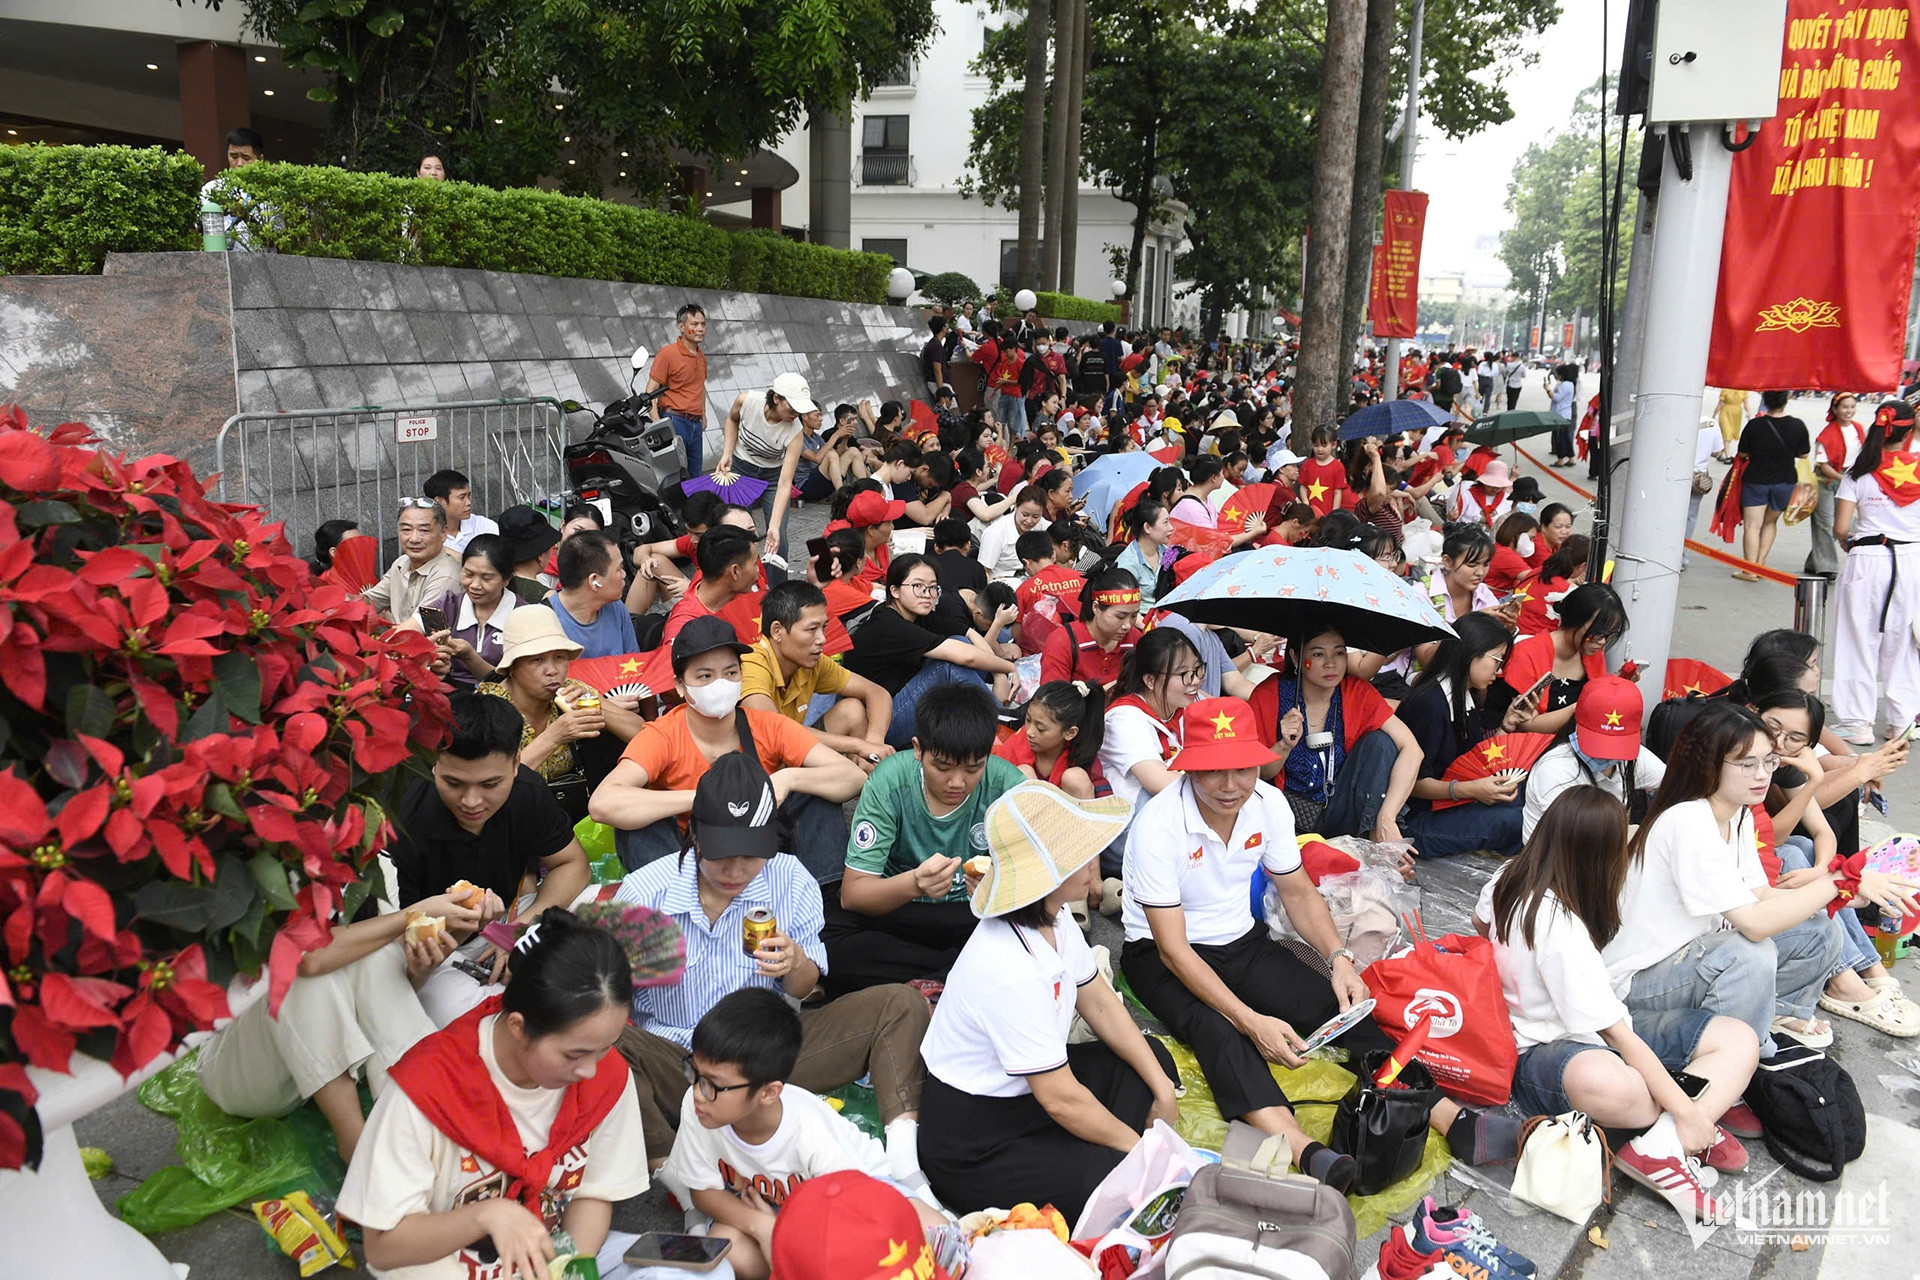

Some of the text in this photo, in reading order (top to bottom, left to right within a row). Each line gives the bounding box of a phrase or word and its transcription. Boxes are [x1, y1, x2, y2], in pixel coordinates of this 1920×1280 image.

[1788, 11, 1832, 51] QUYẾT
[1865, 7, 1909, 47] DỰNG
[1779, 61, 1799, 98] VÀ
[1861, 49, 1901, 90] CHẮC
[1818, 101, 1845, 144] VIỆT
[1844, 109, 1880, 139] NAM
[406, 427, 430, 437] STOP
